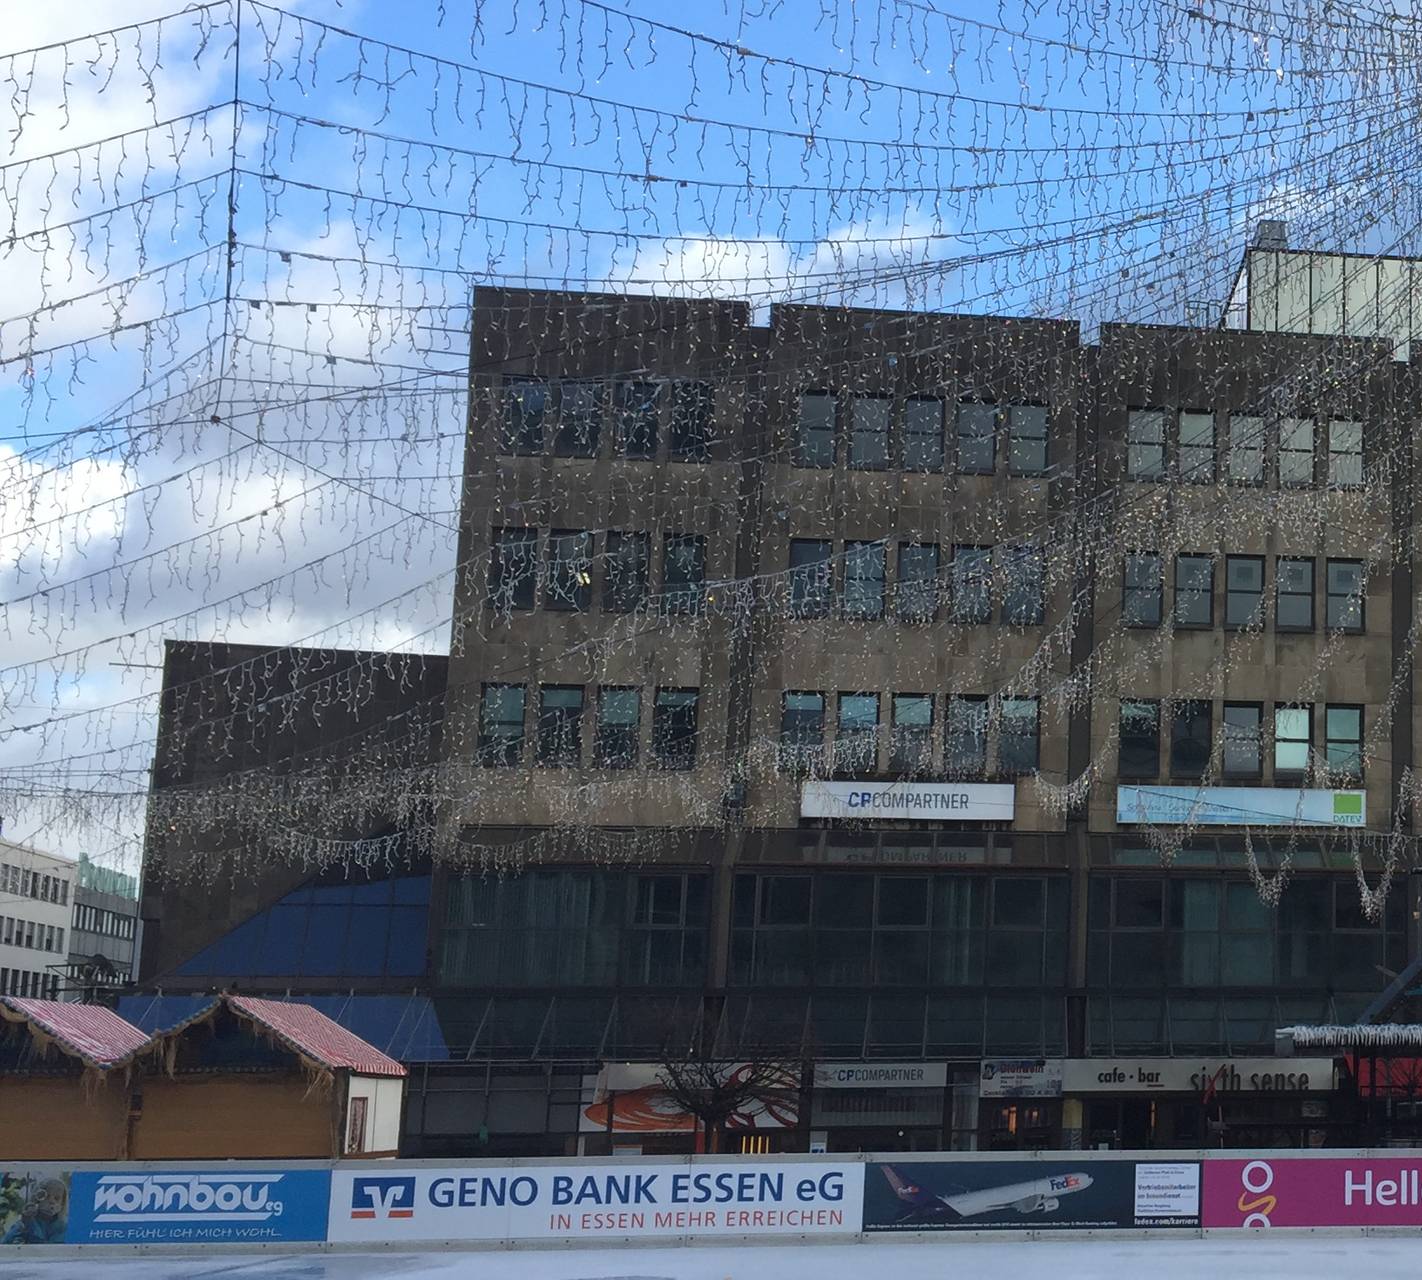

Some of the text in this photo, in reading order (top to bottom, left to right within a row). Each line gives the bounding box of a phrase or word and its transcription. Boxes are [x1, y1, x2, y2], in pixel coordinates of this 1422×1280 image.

[837, 1067, 924, 1082] CPCOMPARTNER
[1097, 1067, 1125, 1084] cafe
[1137, 1065, 1161, 1084] bar
[1250, 1069, 1310, 1091] sense
[428, 1171, 845, 1208] GENO BANK ESSEN eG
[1049, 1174, 1081, 1191] FedEx
[266, 1201, 284, 1216] eg
[550, 1214, 572, 1231] IN
[581, 1212, 646, 1230] ESSEN
[654, 1211, 717, 1228] MEHR
[725, 1209, 845, 1227] ERREICHEN
[89, 1229, 125, 1239] HIER
[169, 1228, 193, 1237] ICH
[196, 1228, 232, 1237] MICH
